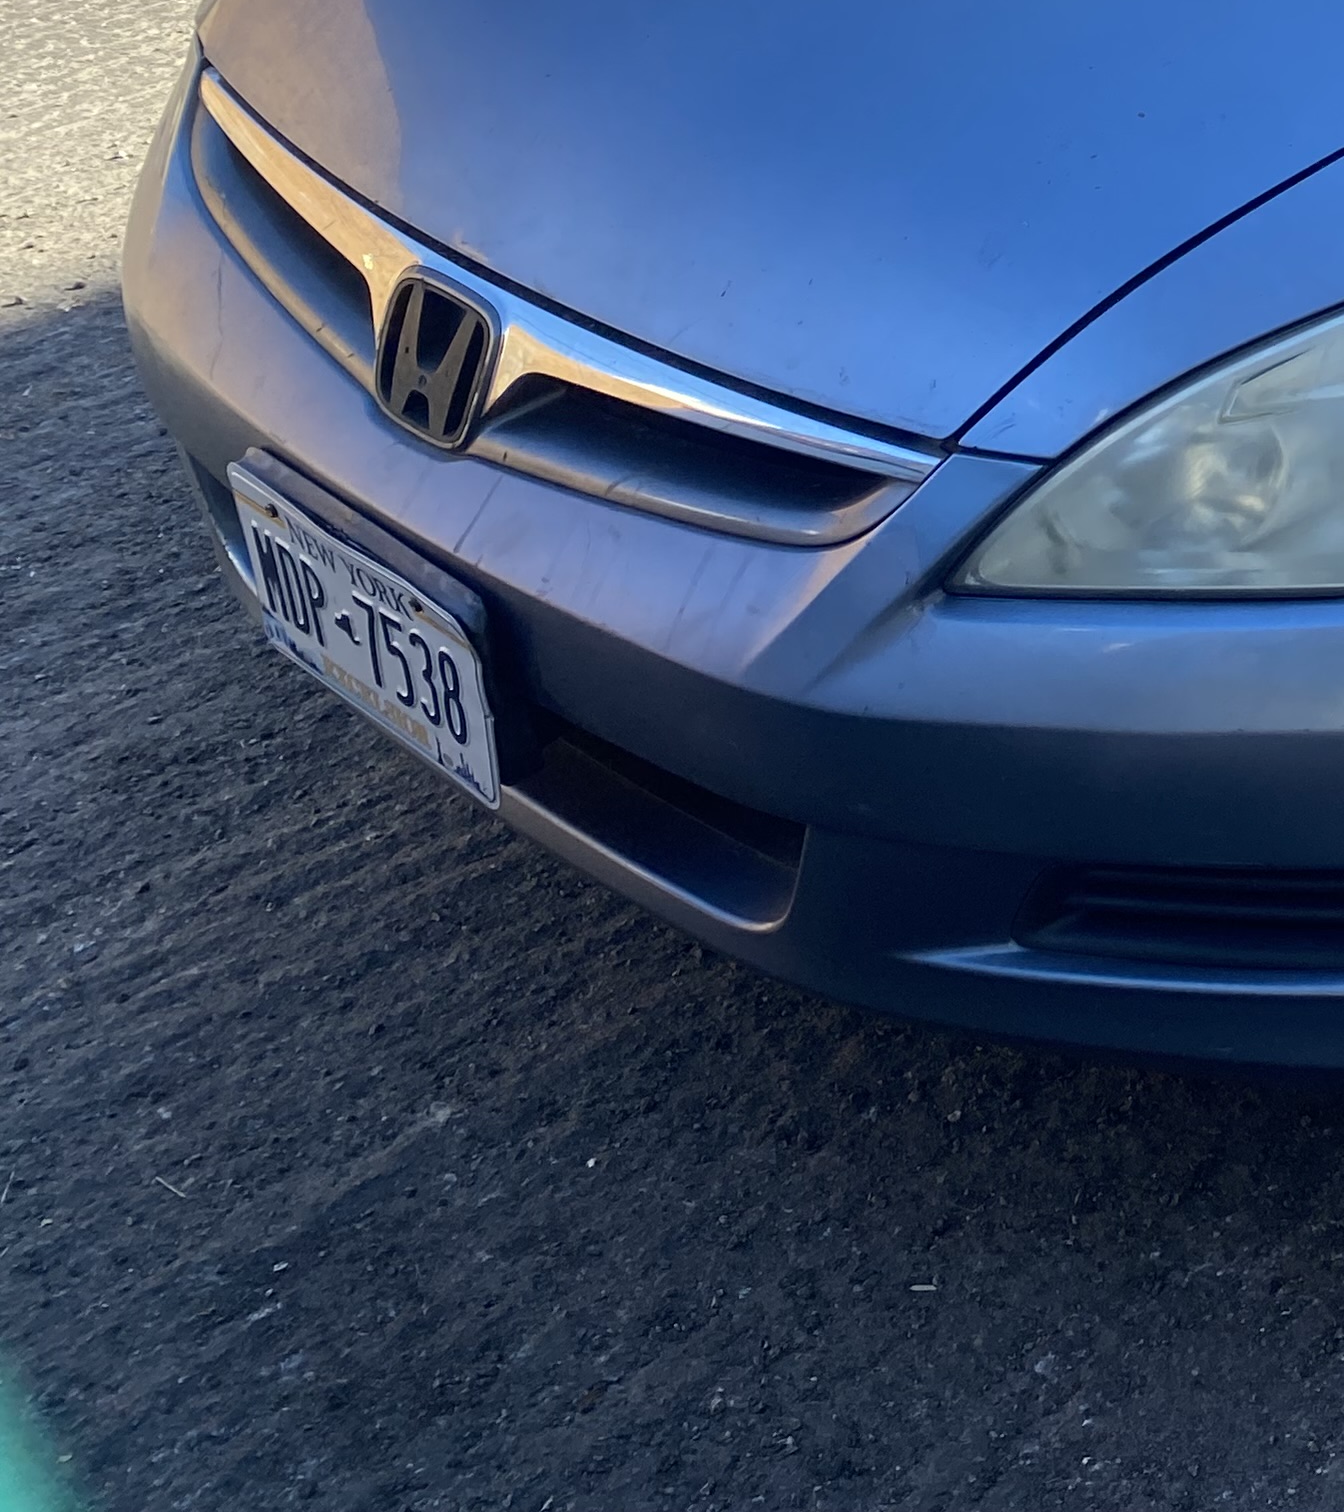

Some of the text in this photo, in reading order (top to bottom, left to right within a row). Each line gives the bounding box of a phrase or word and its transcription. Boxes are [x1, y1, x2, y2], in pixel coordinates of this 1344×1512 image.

[285, 514, 415, 621] NEW YORK
[250, 519, 468, 745] MDP 7538
[320, 652, 434, 752] EXCELSIOR
